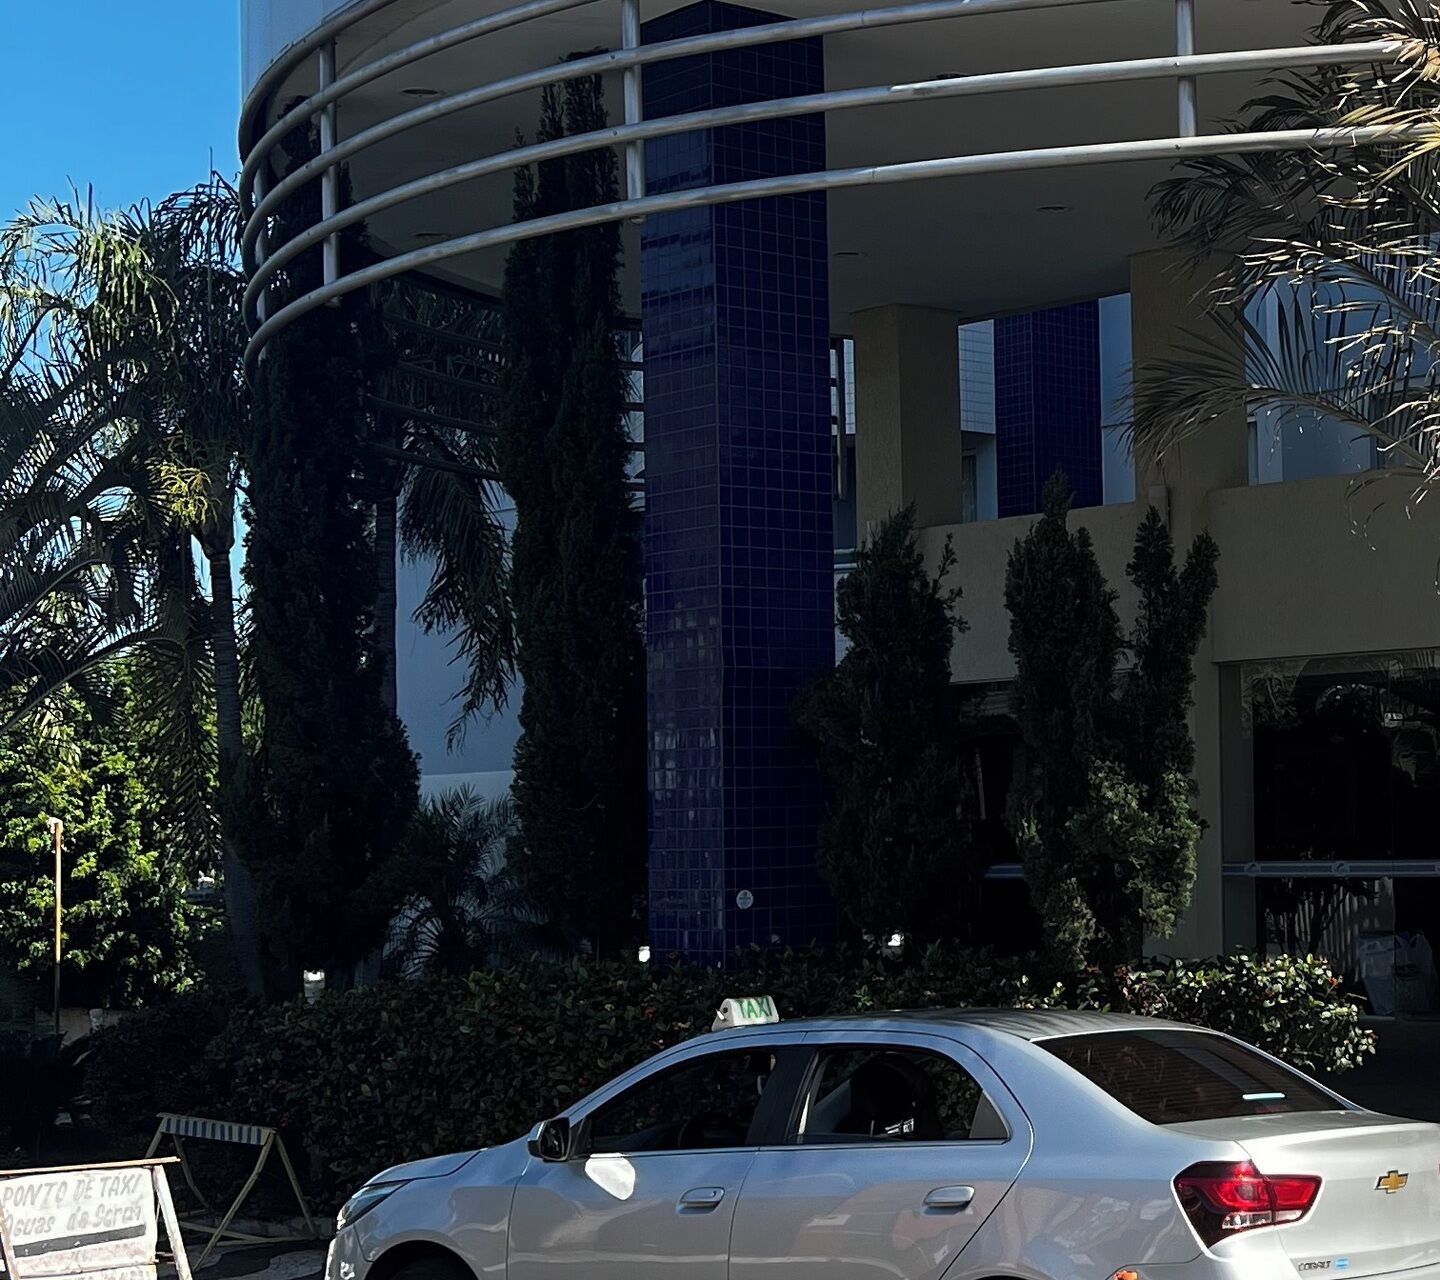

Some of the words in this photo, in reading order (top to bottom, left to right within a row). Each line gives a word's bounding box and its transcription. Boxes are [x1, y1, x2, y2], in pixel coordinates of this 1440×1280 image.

[735, 995, 773, 1019] TAXI
[2, 1180, 68, 1208] PONTO
[73, 1178, 96, 1201] DE
